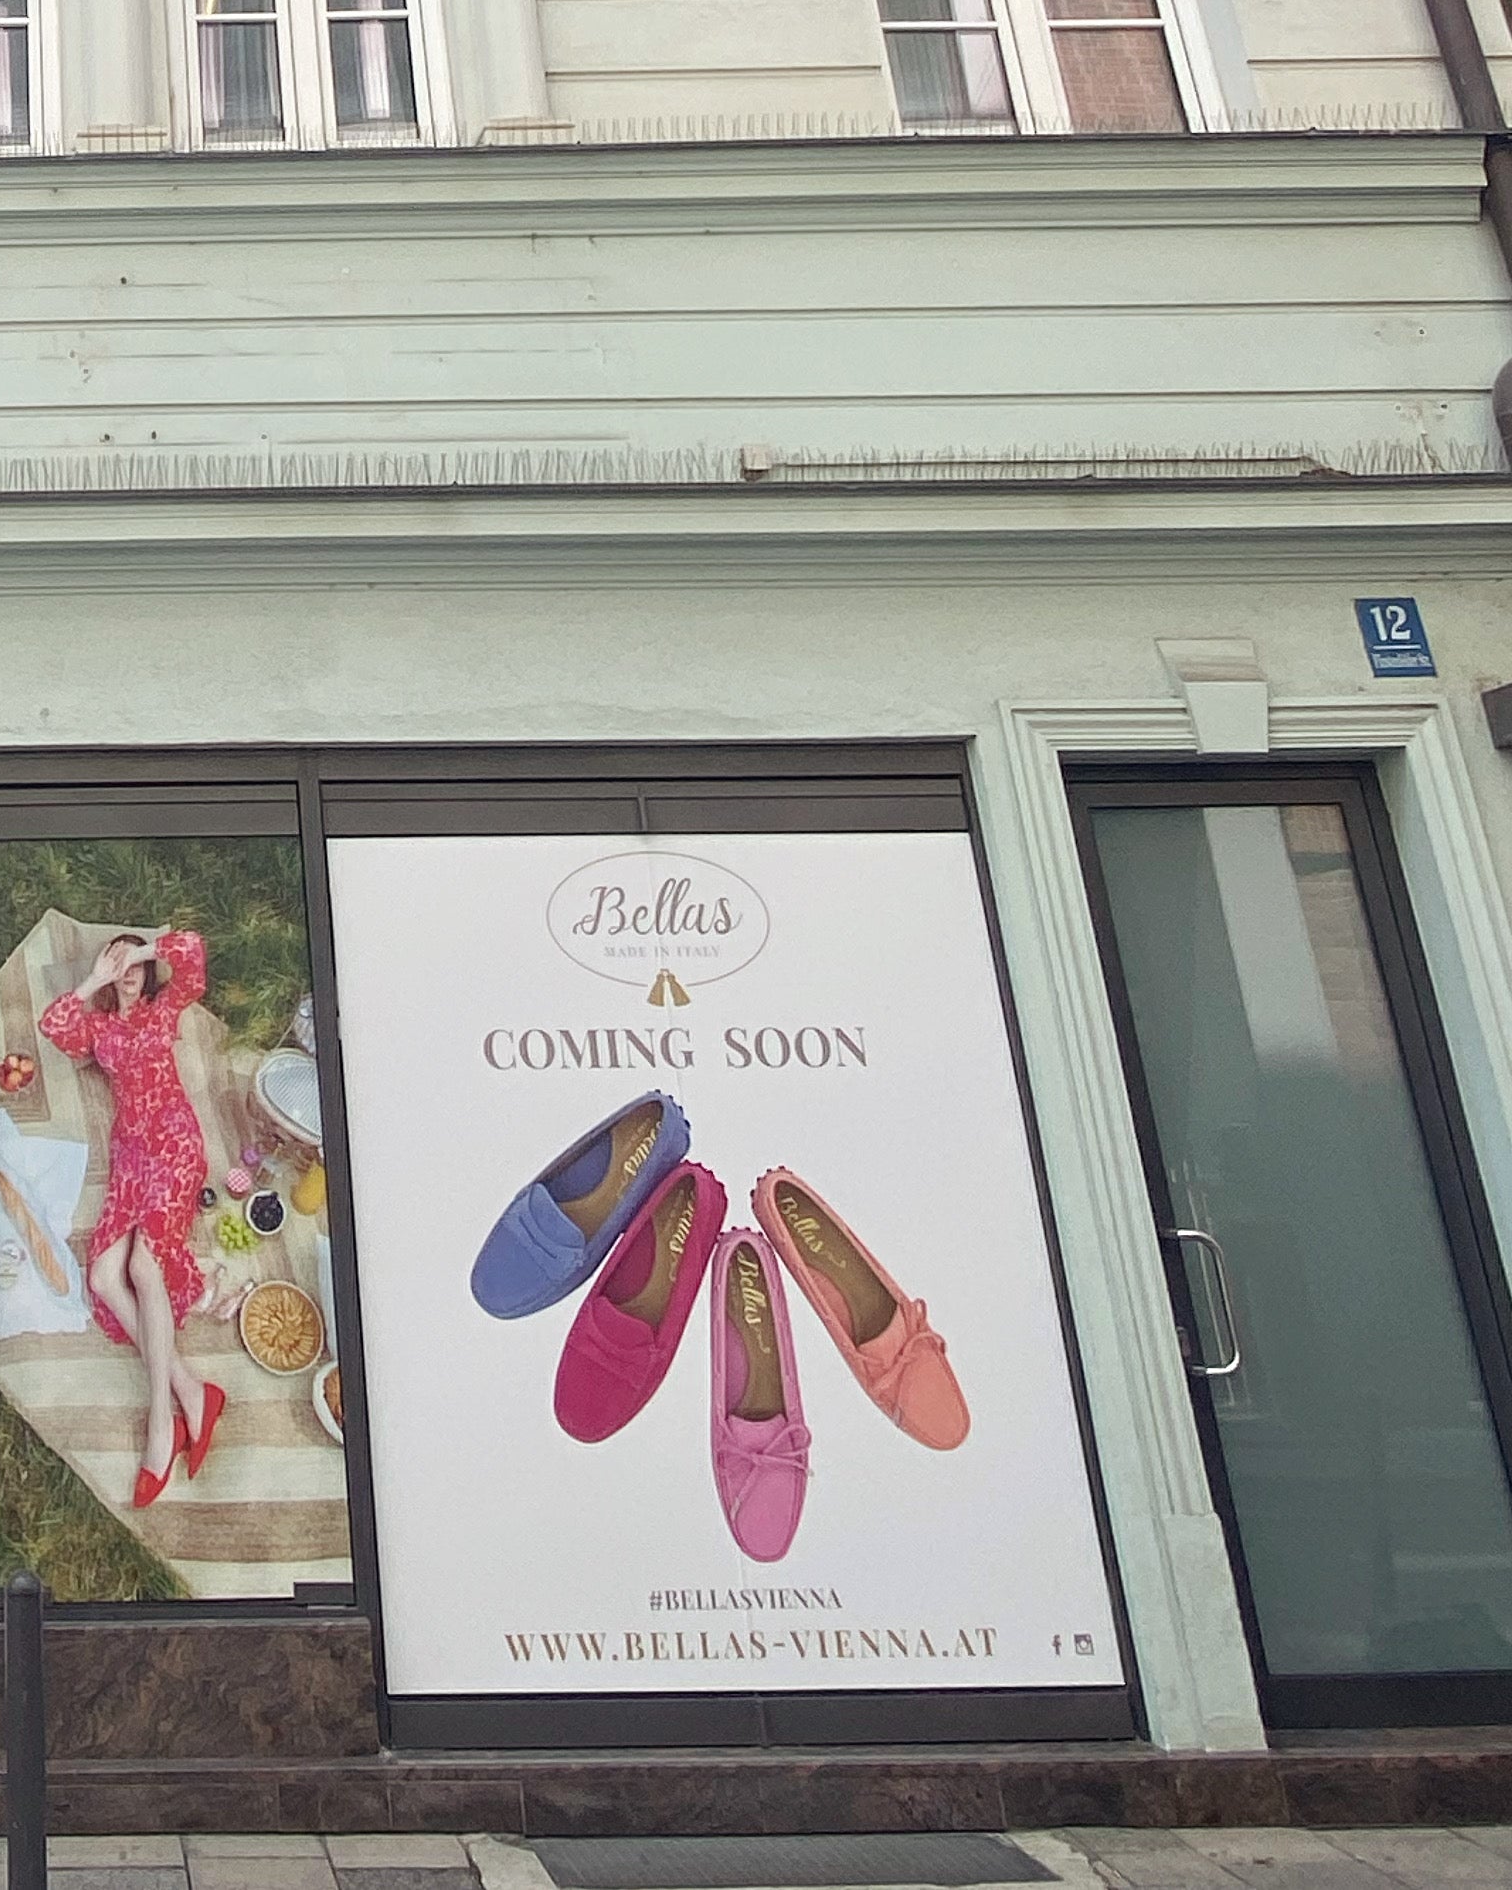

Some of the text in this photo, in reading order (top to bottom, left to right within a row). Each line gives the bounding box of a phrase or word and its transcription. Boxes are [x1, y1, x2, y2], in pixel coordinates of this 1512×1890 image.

[1370, 605, 1411, 642] 12
[572, 877, 744, 936] Bellas
[604, 945, 721, 958] MADE IN ITALY
[482, 1026, 869, 1071] COMING SOON
[779, 1197, 824, 1253] Bellas
[737, 1249, 767, 1325] Bellas
[649, 1588, 844, 1611] #BELLASVIENNA
[504, 1628, 1000, 1662] WWW.BELLAS-VIENNA.AT
